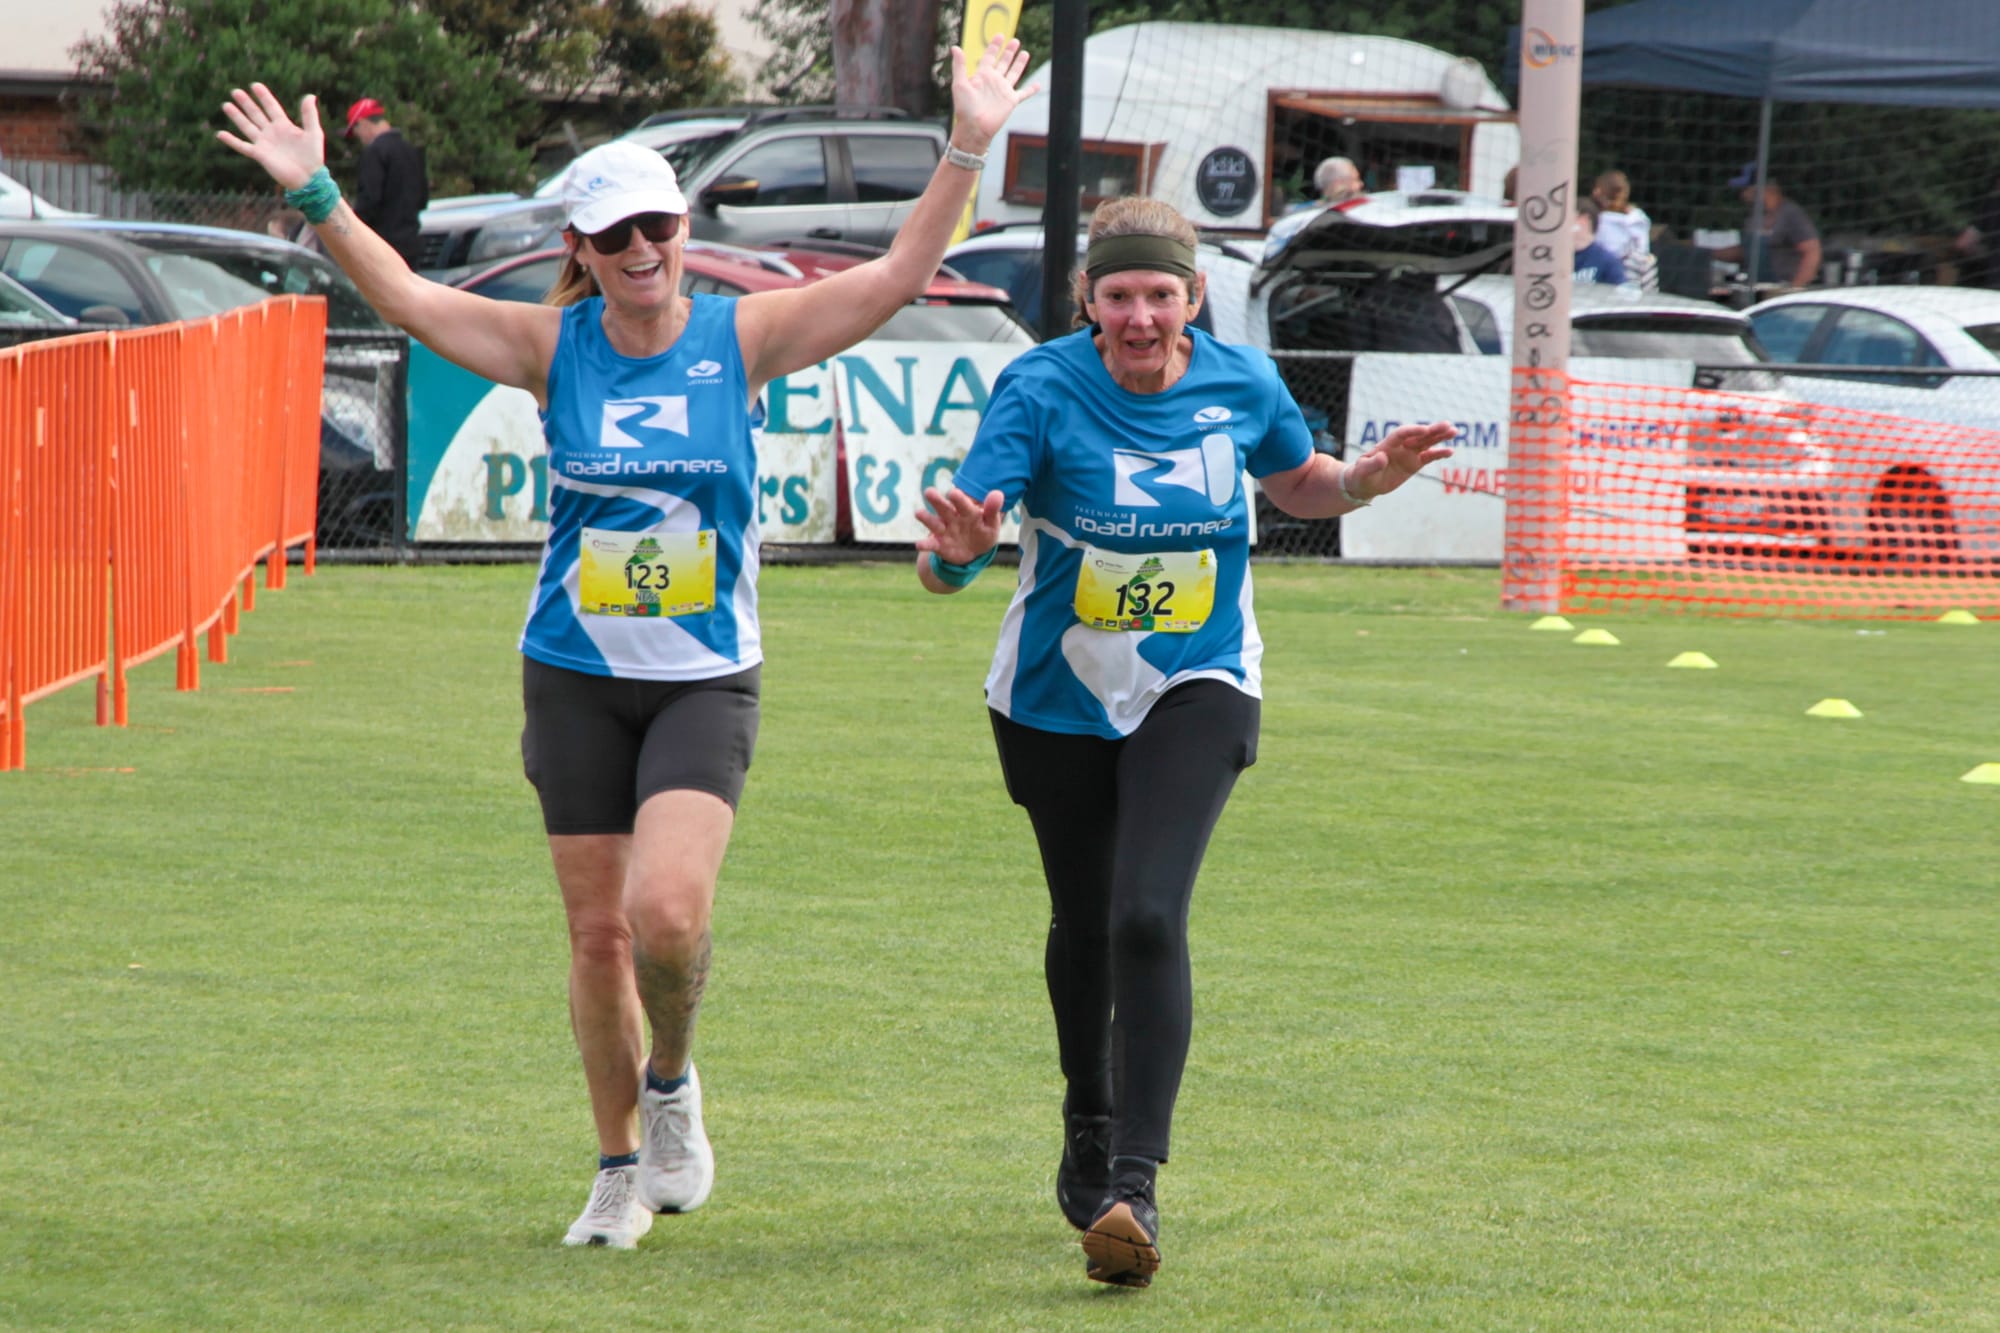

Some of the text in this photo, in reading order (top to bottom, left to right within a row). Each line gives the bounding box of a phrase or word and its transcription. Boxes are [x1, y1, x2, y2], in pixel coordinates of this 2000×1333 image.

[566, 453, 728, 475] road runners
[854, 455, 900, 524] &
[1075, 504, 1128, 519] PAKENHAM
[1075, 513, 1234, 538] road runners
[625, 563, 670, 590] 123
[1116, 581, 1176, 617] 132
